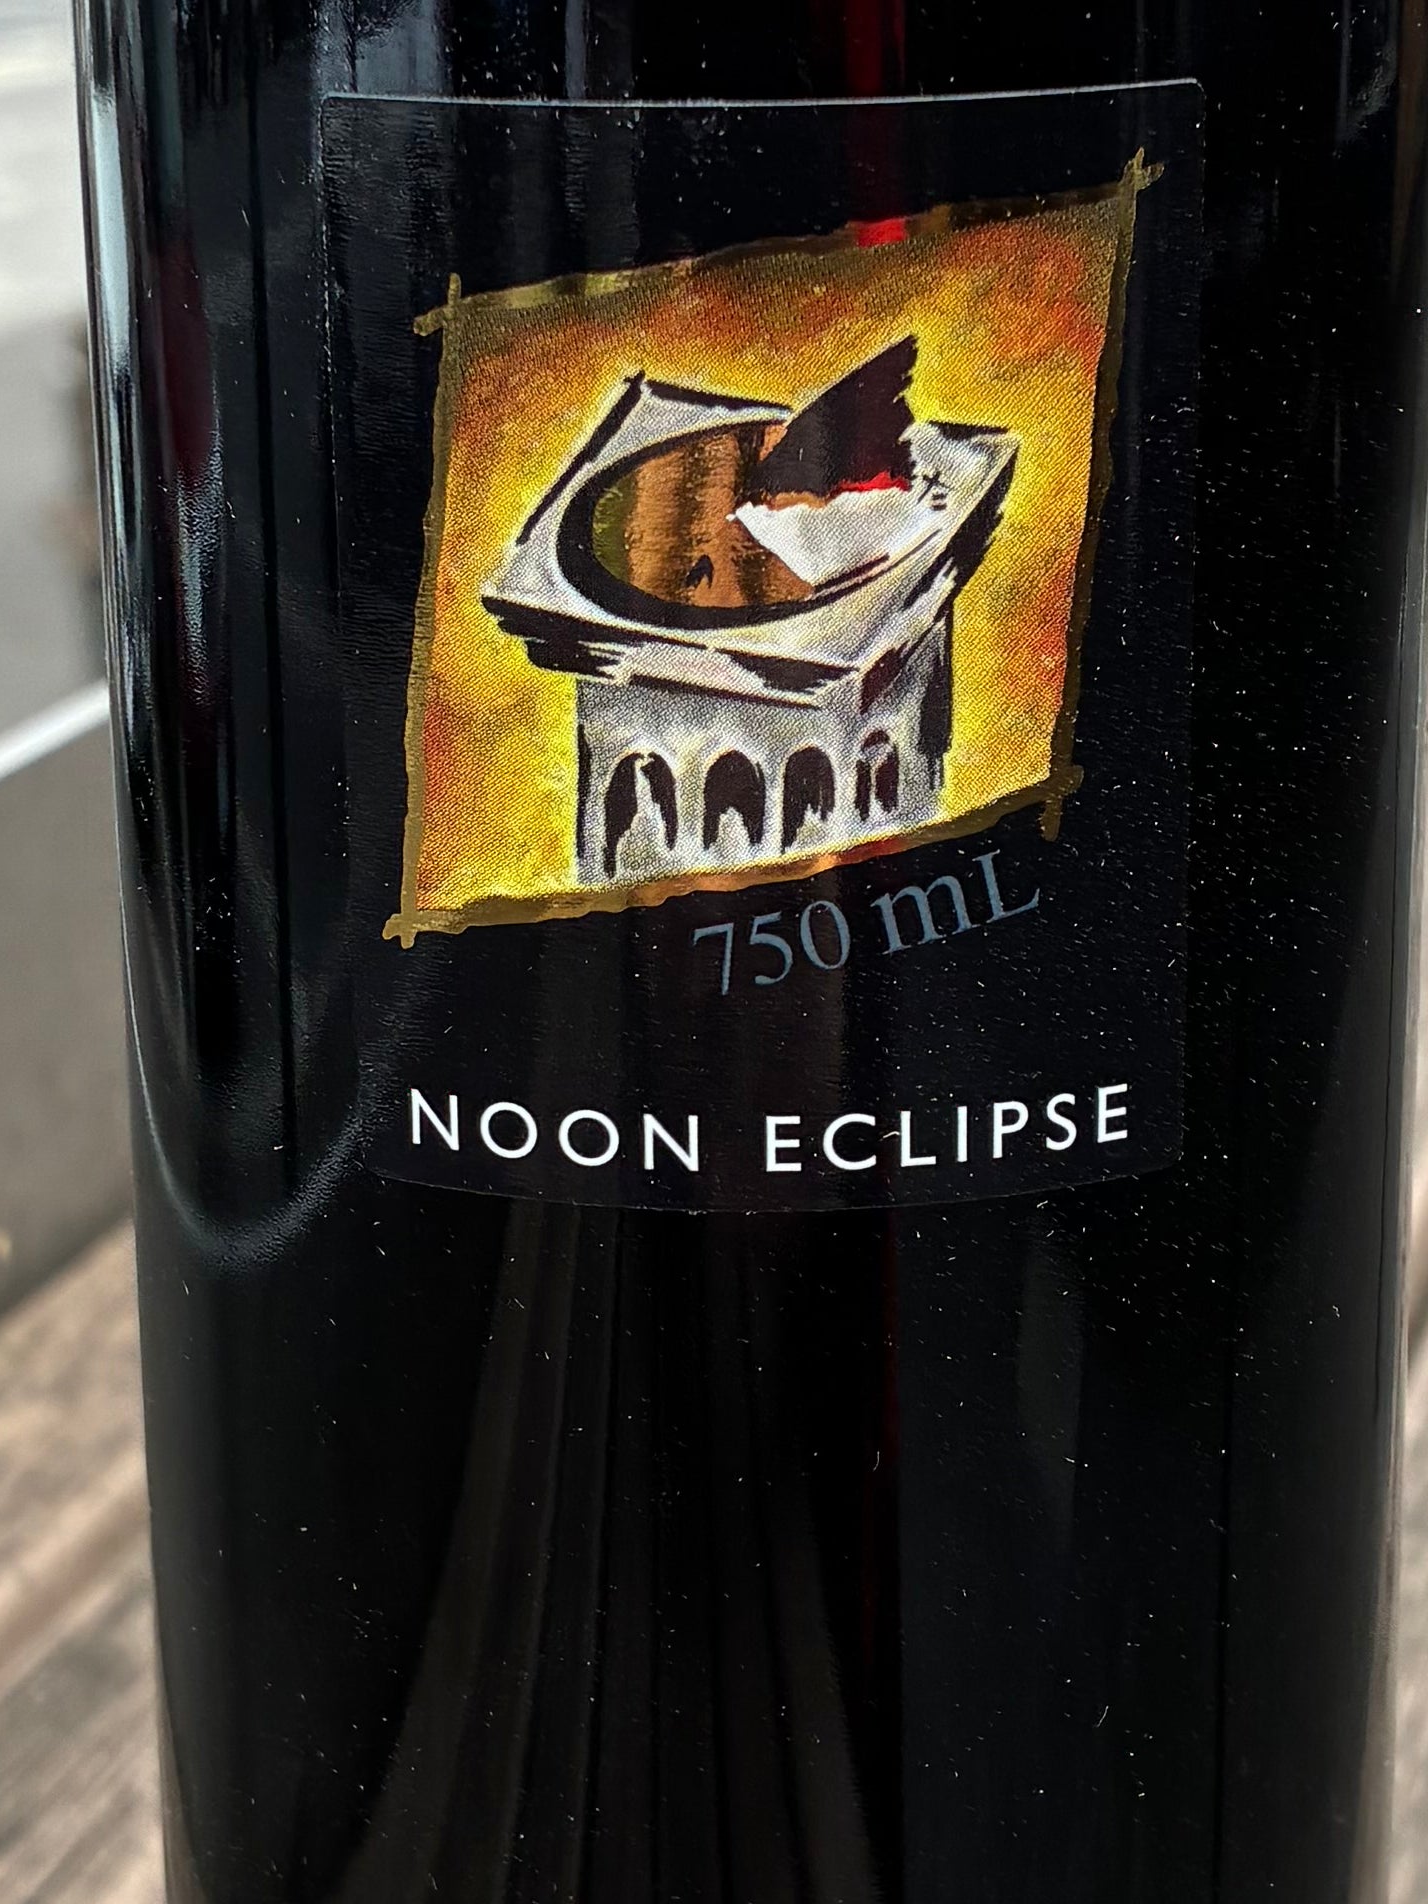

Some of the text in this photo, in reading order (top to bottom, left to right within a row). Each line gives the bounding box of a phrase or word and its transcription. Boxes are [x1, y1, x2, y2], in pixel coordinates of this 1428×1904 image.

[692, 848, 1041, 996] 750 mL
[410, 1082, 1129, 1173] NOON ECLIPSE
